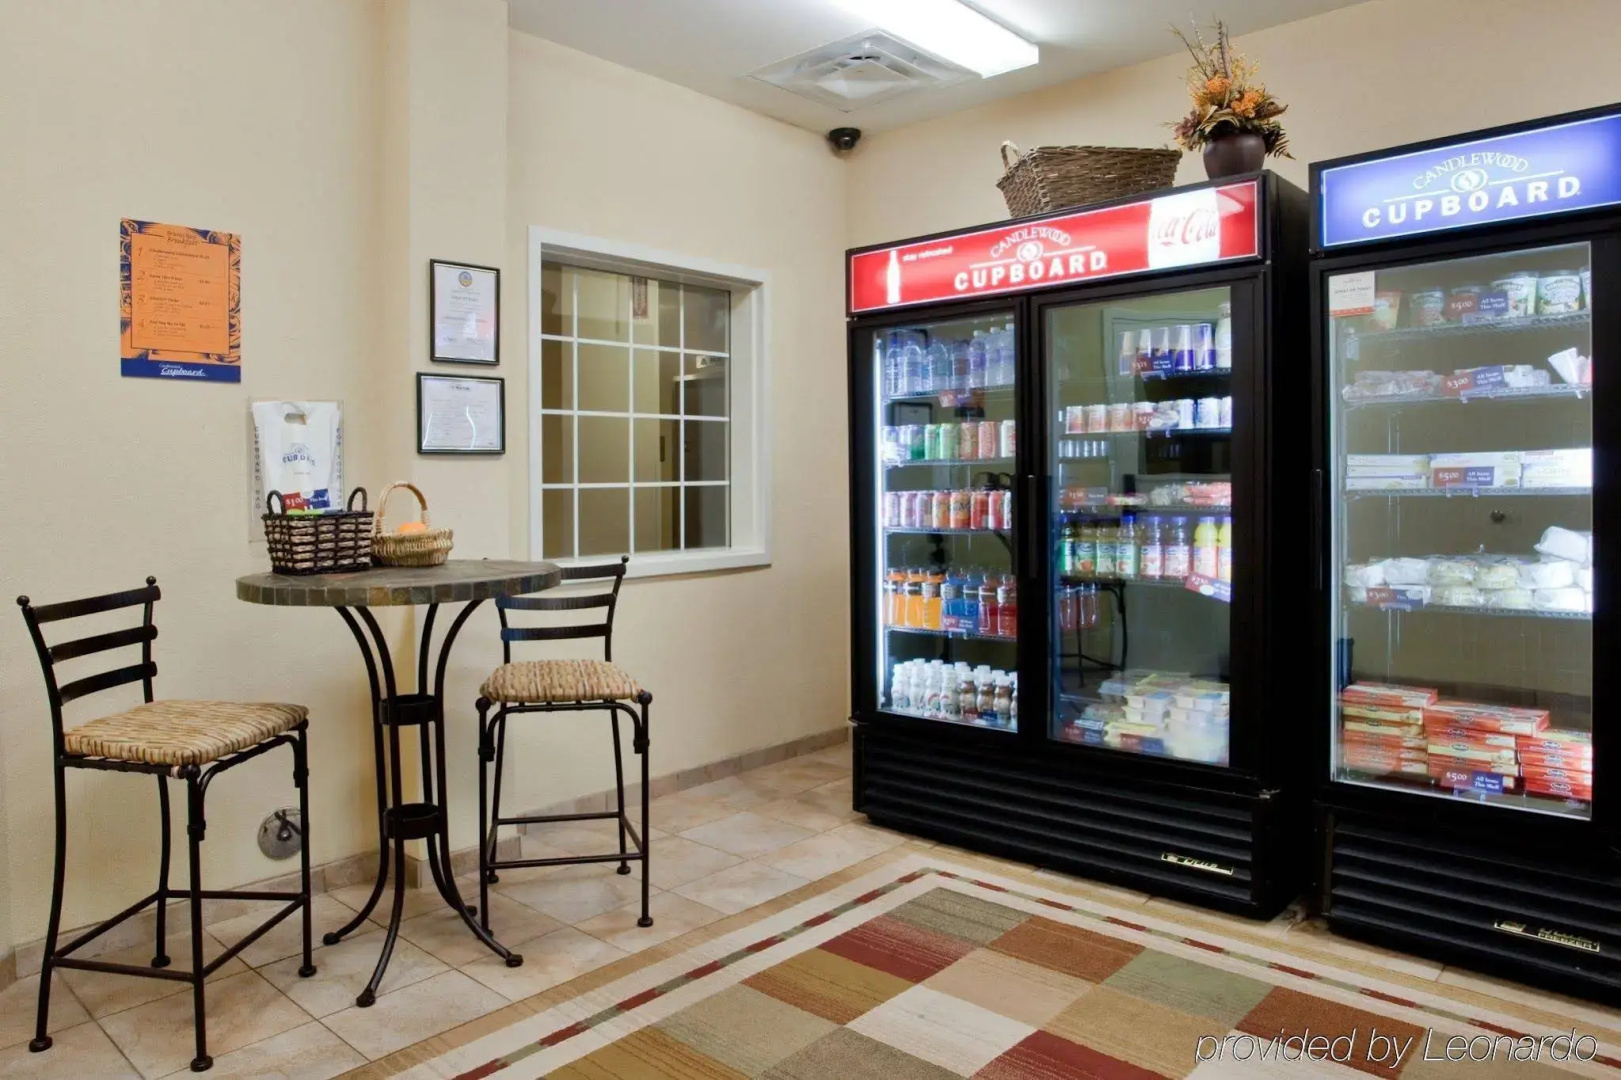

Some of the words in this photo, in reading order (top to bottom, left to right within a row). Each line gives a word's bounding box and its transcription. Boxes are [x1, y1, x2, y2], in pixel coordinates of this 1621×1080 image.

[1412, 151, 1529, 190] CANDLEWOOD
[1361, 175, 1582, 229] CUPBOARD
[989, 226, 1072, 258] CANDLEWOOD
[953, 250, 1107, 291] CUPBOARD
